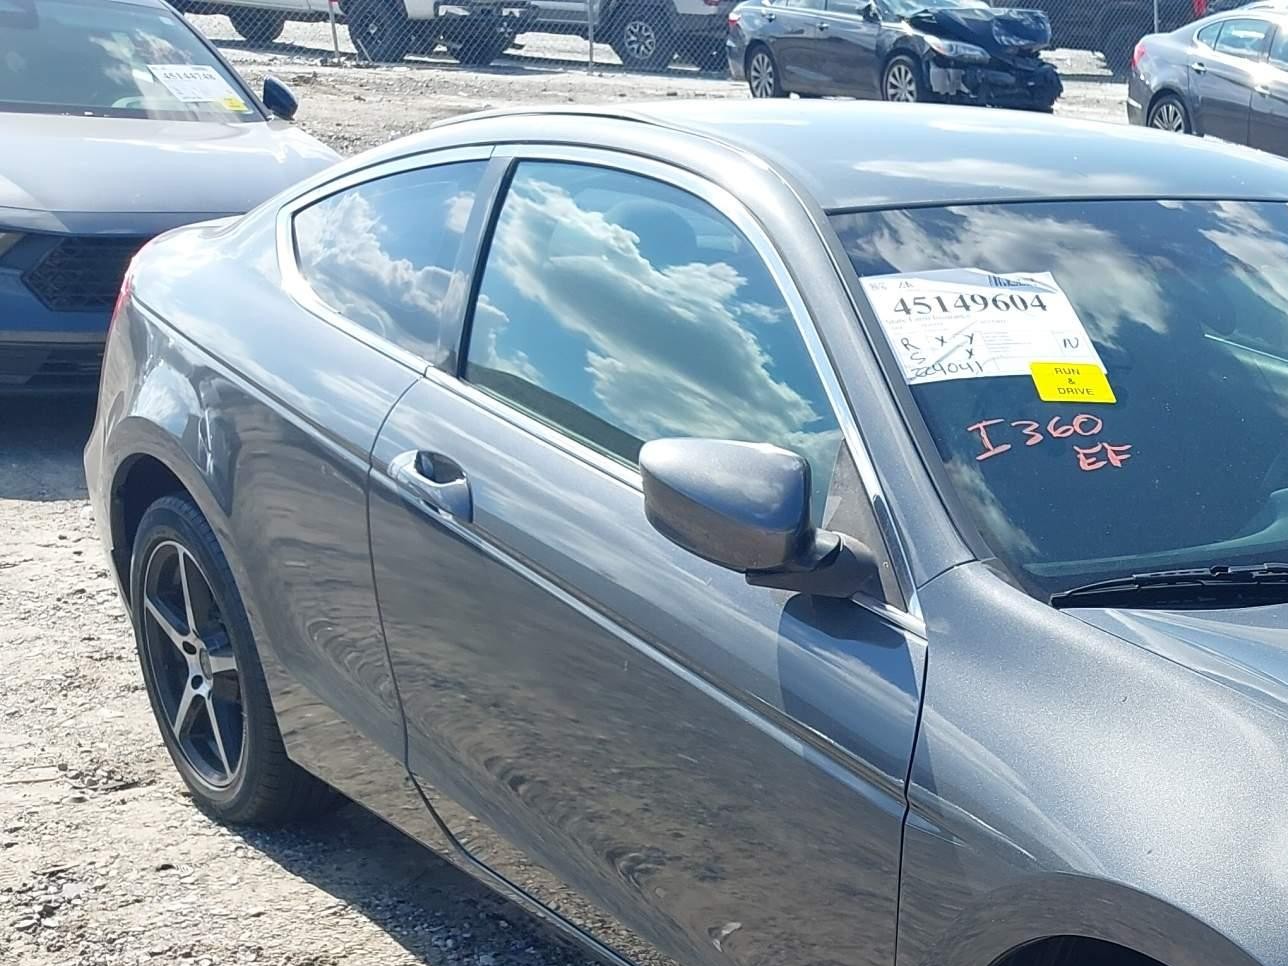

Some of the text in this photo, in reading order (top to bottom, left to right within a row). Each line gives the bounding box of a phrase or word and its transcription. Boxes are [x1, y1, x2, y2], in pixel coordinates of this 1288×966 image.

[894, 294, 1048, 315] 45149604
[1068, 377, 1076, 385] &
[1057, 387, 1095, 396] DRIVE
[1073, 442, 1133, 471] EF
